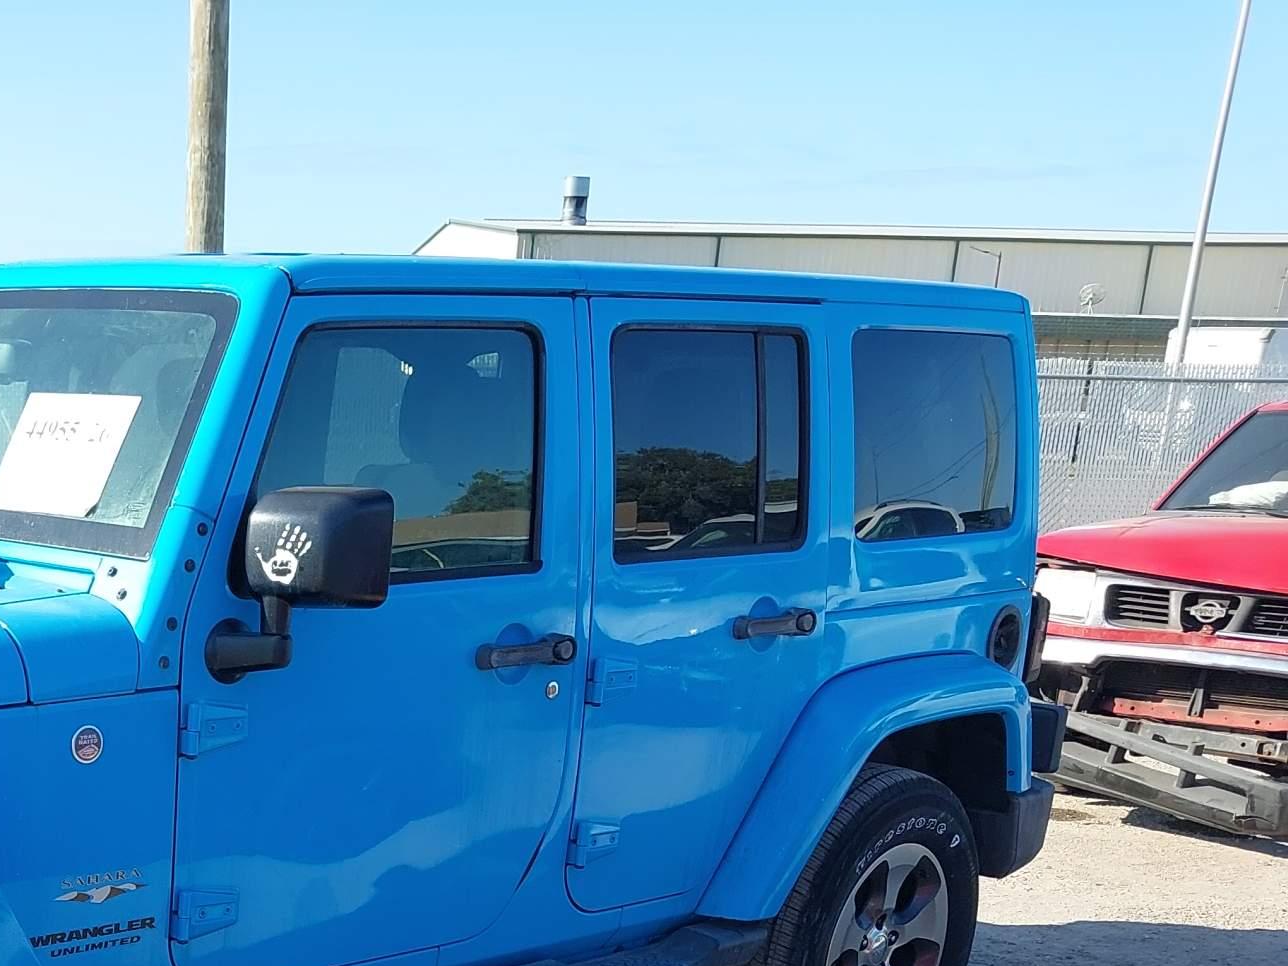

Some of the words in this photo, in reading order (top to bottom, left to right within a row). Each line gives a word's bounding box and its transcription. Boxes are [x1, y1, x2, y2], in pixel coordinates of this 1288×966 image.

[62, 867, 142, 889] SAHARA
[29, 917, 156, 948] WRANGLER
[51, 935, 141, 957] UNLIMITED
